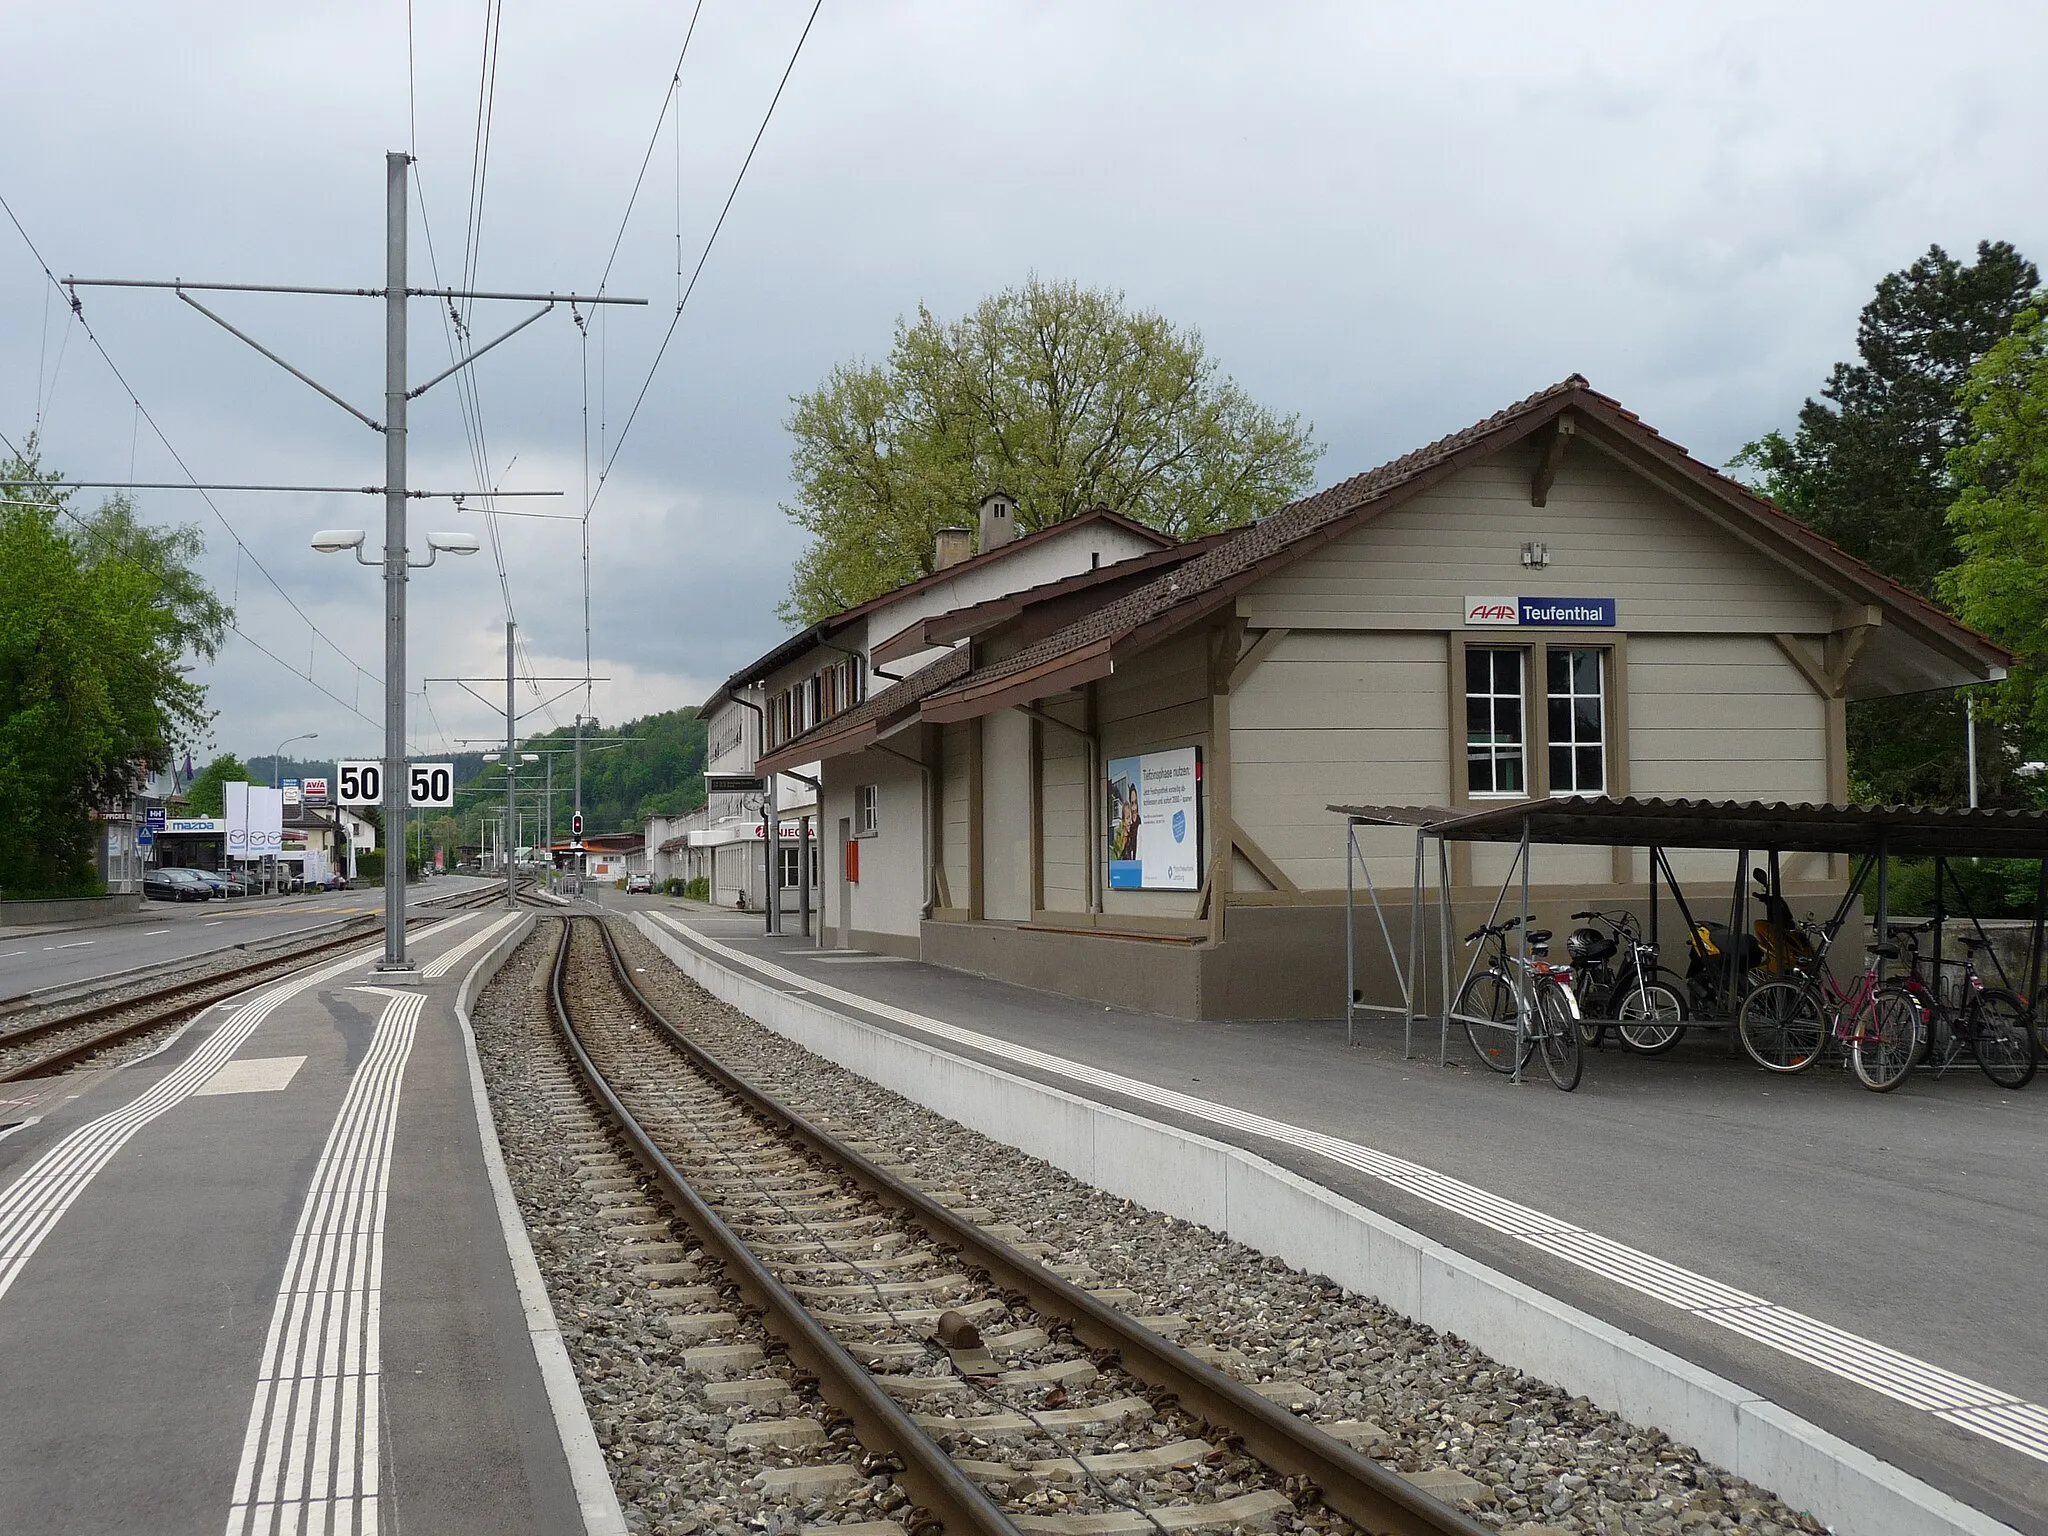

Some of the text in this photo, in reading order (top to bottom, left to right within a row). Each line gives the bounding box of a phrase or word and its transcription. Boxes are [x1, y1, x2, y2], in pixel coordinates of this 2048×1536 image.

[1522, 605, 1603, 621] Teufenthal
[341, 767, 380, 800] 50
[411, 769, 450, 802] 50
